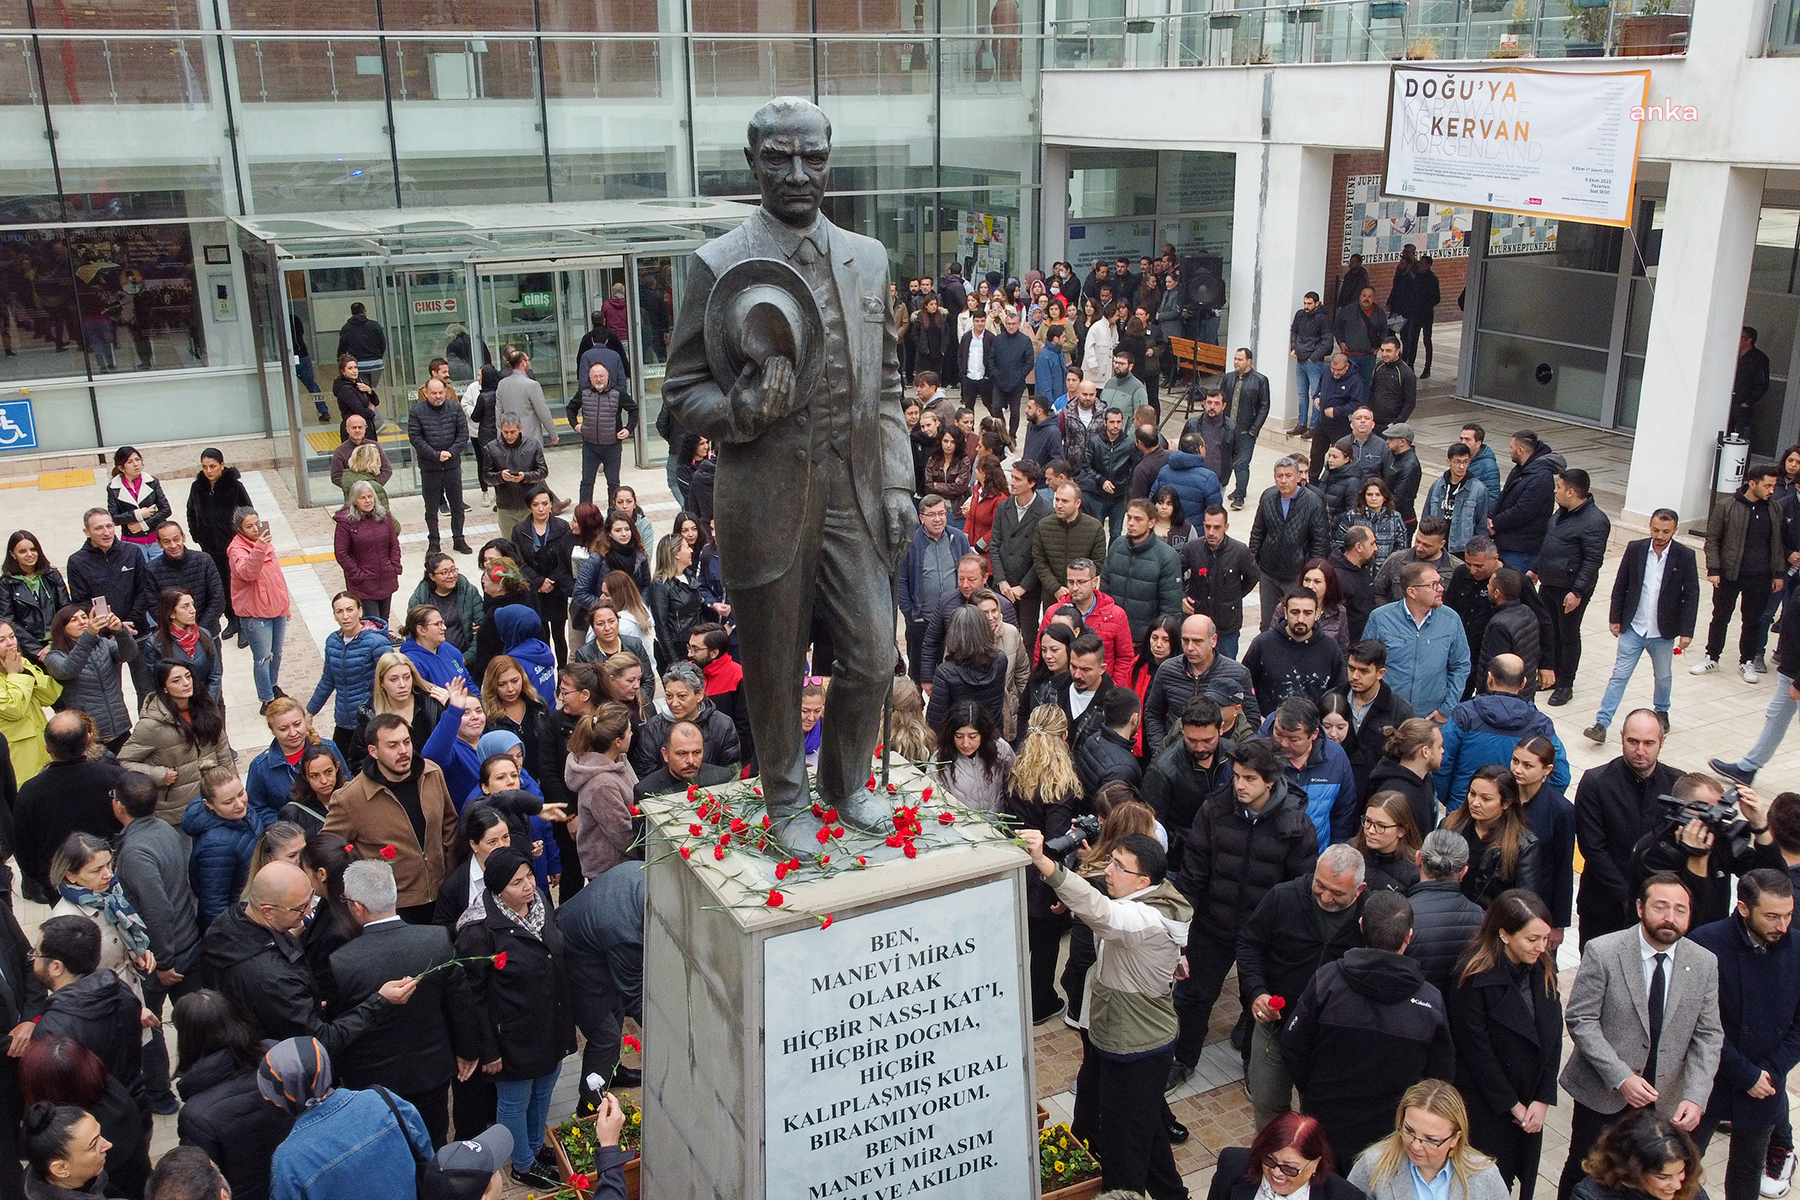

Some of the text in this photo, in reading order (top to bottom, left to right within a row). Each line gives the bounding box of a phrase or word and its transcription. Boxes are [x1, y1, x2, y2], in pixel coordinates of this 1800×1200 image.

[1404, 97, 1532, 121] KARAWANE
[1430, 115, 1530, 142] KERVAN
[1401, 131, 1543, 163] MORGENLAND
[1358, 176, 1382, 186] JUPIT
[1342, 176, 1356, 265] JUPITER NEPTUNE
[1361, 253, 1383, 264] PITER
[1384, 252, 1403, 262] MARS
[1414, 250, 1428, 260] RTH
[1429, 248, 1452, 259] VENUS
[1489, 241, 1556, 254] ATURN NEPTUNE PLU
[415, 301, 442, 314] ÇIKIŞ
[524, 292, 550, 306] GİRİŞ
[870, 926, 919, 953] BEN,
[811, 937, 976, 995] MANEVİ MİRAS
[849, 971, 942, 1010] OLARAK
[783, 1018, 863, 1055] HİÇBİR
[868, 998, 936, 1031] NASS-I
[810, 1014, 980, 1075] HİÇBİR DOGMA,
[859, 1050, 936, 1086] HİÇBİR
[783, 1053, 1009, 1134] KALIPLAŞMIŞ KURAL
[809, 1083, 990, 1152] BIRAKMIYORUM.
[865, 1123, 935, 1160] BENİM
[808, 1129, 994, 1200] MANEVİ MİRASIM
[874, 1152, 998, 1200] VE AKILDIR.
